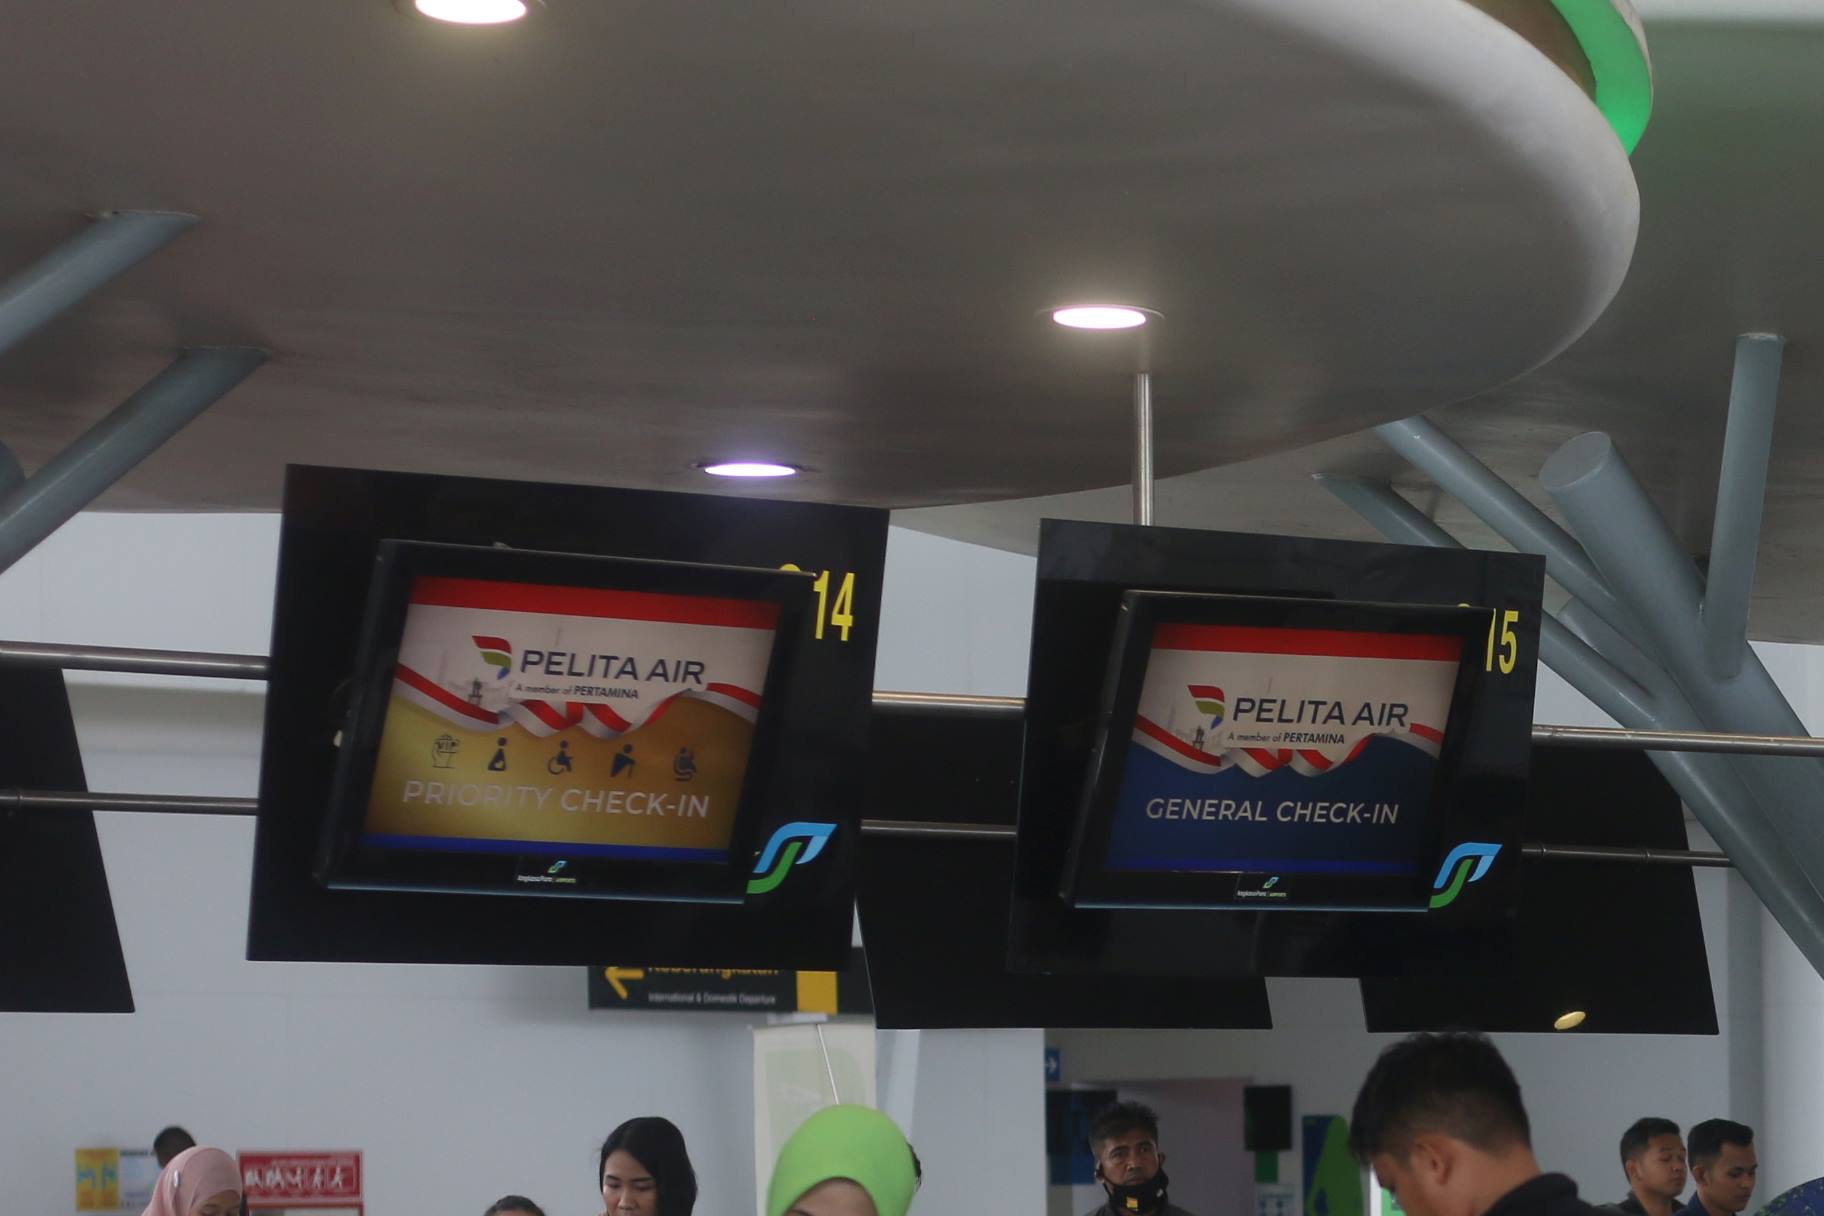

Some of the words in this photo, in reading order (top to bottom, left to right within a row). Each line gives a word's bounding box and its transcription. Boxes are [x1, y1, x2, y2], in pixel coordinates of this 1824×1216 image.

[780, 563, 855, 641] 14
[520, 649, 643, 683] PELITA
[644, 658, 705, 686] AIR
[526, 686, 560, 694] member
[562, 687, 571, 695] of
[573, 685, 639, 699] PERTAMINA
[1233, 698, 1346, 727] PELITA
[1351, 702, 1409, 728] AIR
[1228, 732, 1234, 741] A
[1237, 733, 1270, 743] member
[1272, 734, 1282, 743] of
[1283, 732, 1345, 745] PERTAMINA
[402, 779, 554, 810] PRIORITY
[560, 787, 710, 818] CHECK-IN
[1146, 798, 1268, 822] GENERAL
[1276, 800, 1399, 825] CHECK-IN
